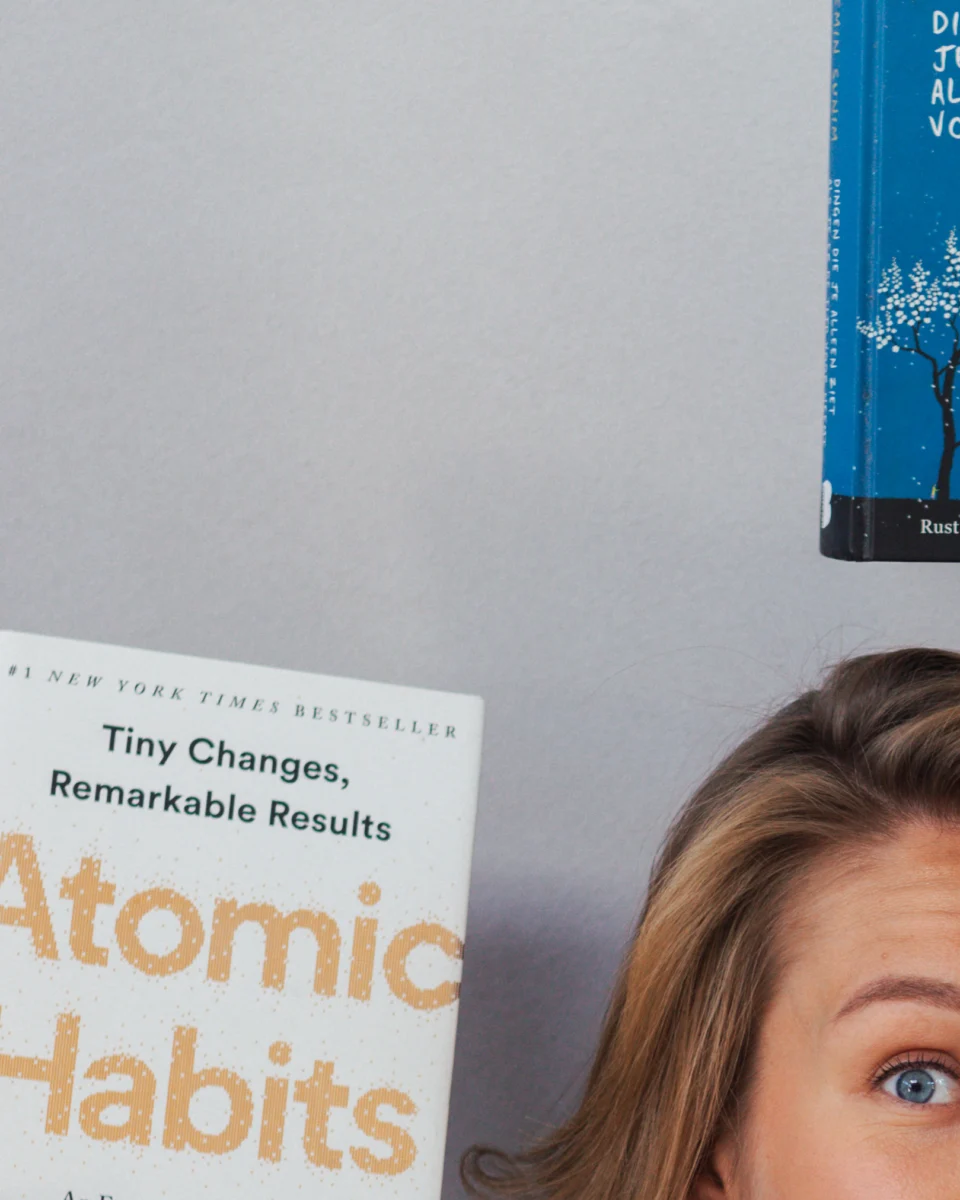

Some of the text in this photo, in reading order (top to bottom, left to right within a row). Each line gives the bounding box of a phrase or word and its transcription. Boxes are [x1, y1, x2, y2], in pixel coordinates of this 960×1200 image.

[832, 179, 841, 240] DINGEN
[832, 248, 840, 272] DIE
[831, 282, 839, 301] JE
[829, 310, 839, 369] ALLEEN
[828, 377, 837, 416] ZIET
[920, 519, 960, 536] Rust
[8, 664, 458, 739] #1 NEW YORK TIMES BESTSELLER
[102, 724, 350, 790] Tiny Changes,
[50, 769, 392, 842] Remarkable Results
[0, 830, 464, 1011] Atomic
